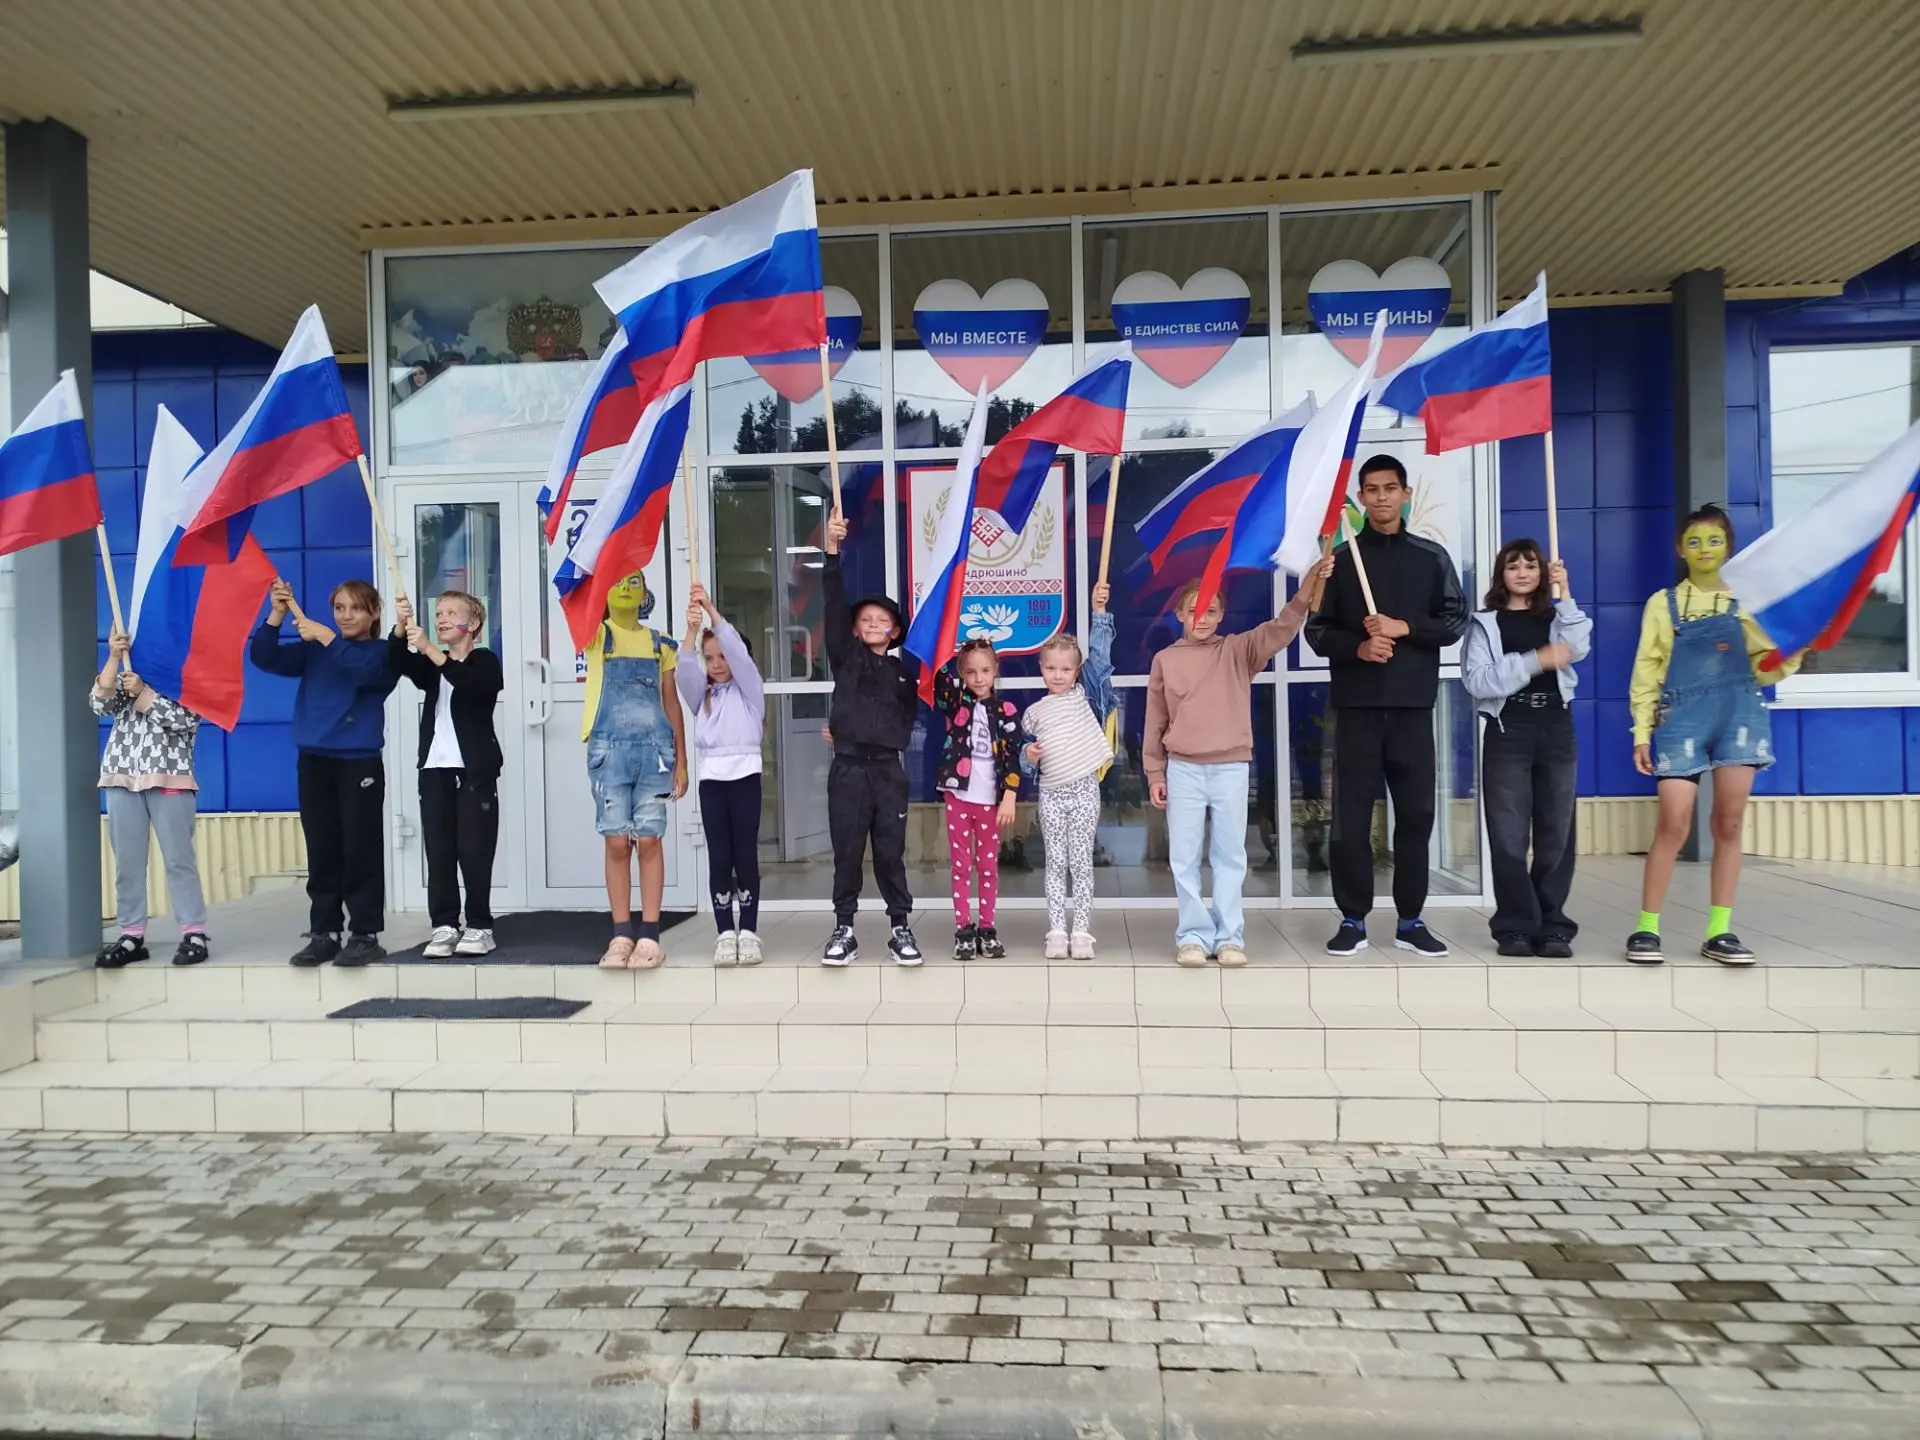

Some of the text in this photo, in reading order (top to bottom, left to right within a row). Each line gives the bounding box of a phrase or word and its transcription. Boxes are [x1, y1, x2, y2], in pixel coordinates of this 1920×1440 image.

[1327, 309, 1433, 327] МЫ ЕИНЫ
[1124, 321, 1239, 336] В ЕДИНСТВЕ СИЛА
[930, 331, 1027, 345] МЫ ВМЕСТЕ
[964, 568, 1028, 579] ндрюшино
[1027, 599, 1051, 611] 1901
